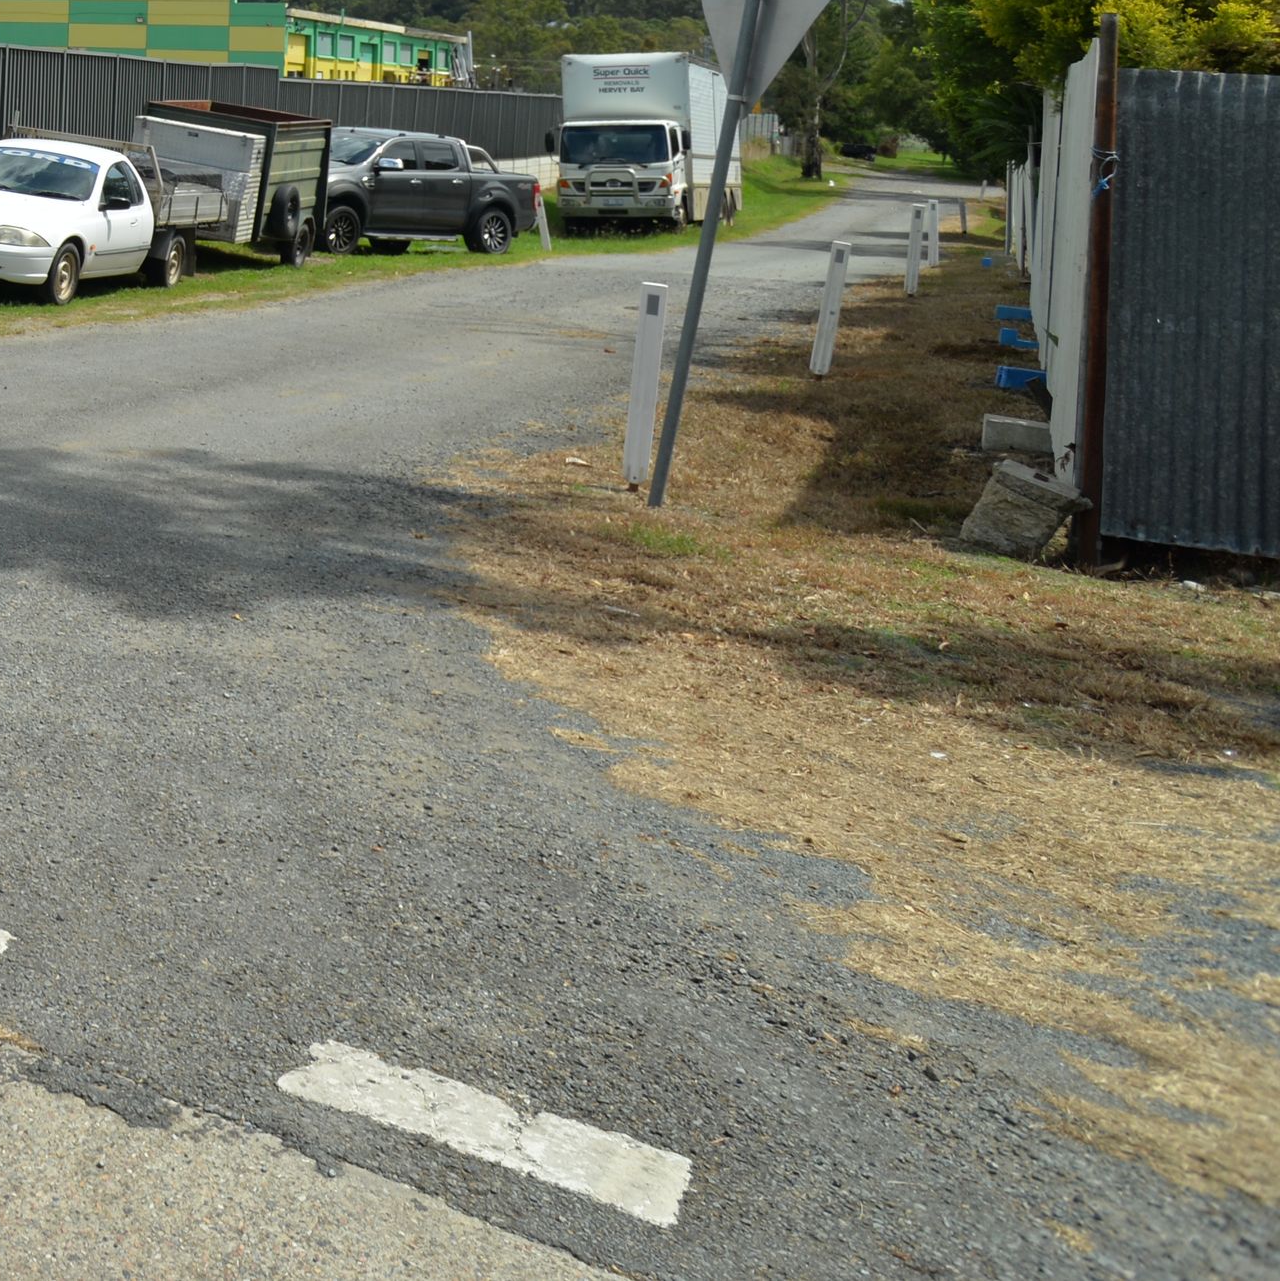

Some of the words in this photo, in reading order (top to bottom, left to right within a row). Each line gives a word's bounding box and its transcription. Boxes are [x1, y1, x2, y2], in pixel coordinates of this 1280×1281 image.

[593, 68, 619, 77] Super
[623, 67, 649, 76] Quick
[598, 86, 628, 94] HERVEY
